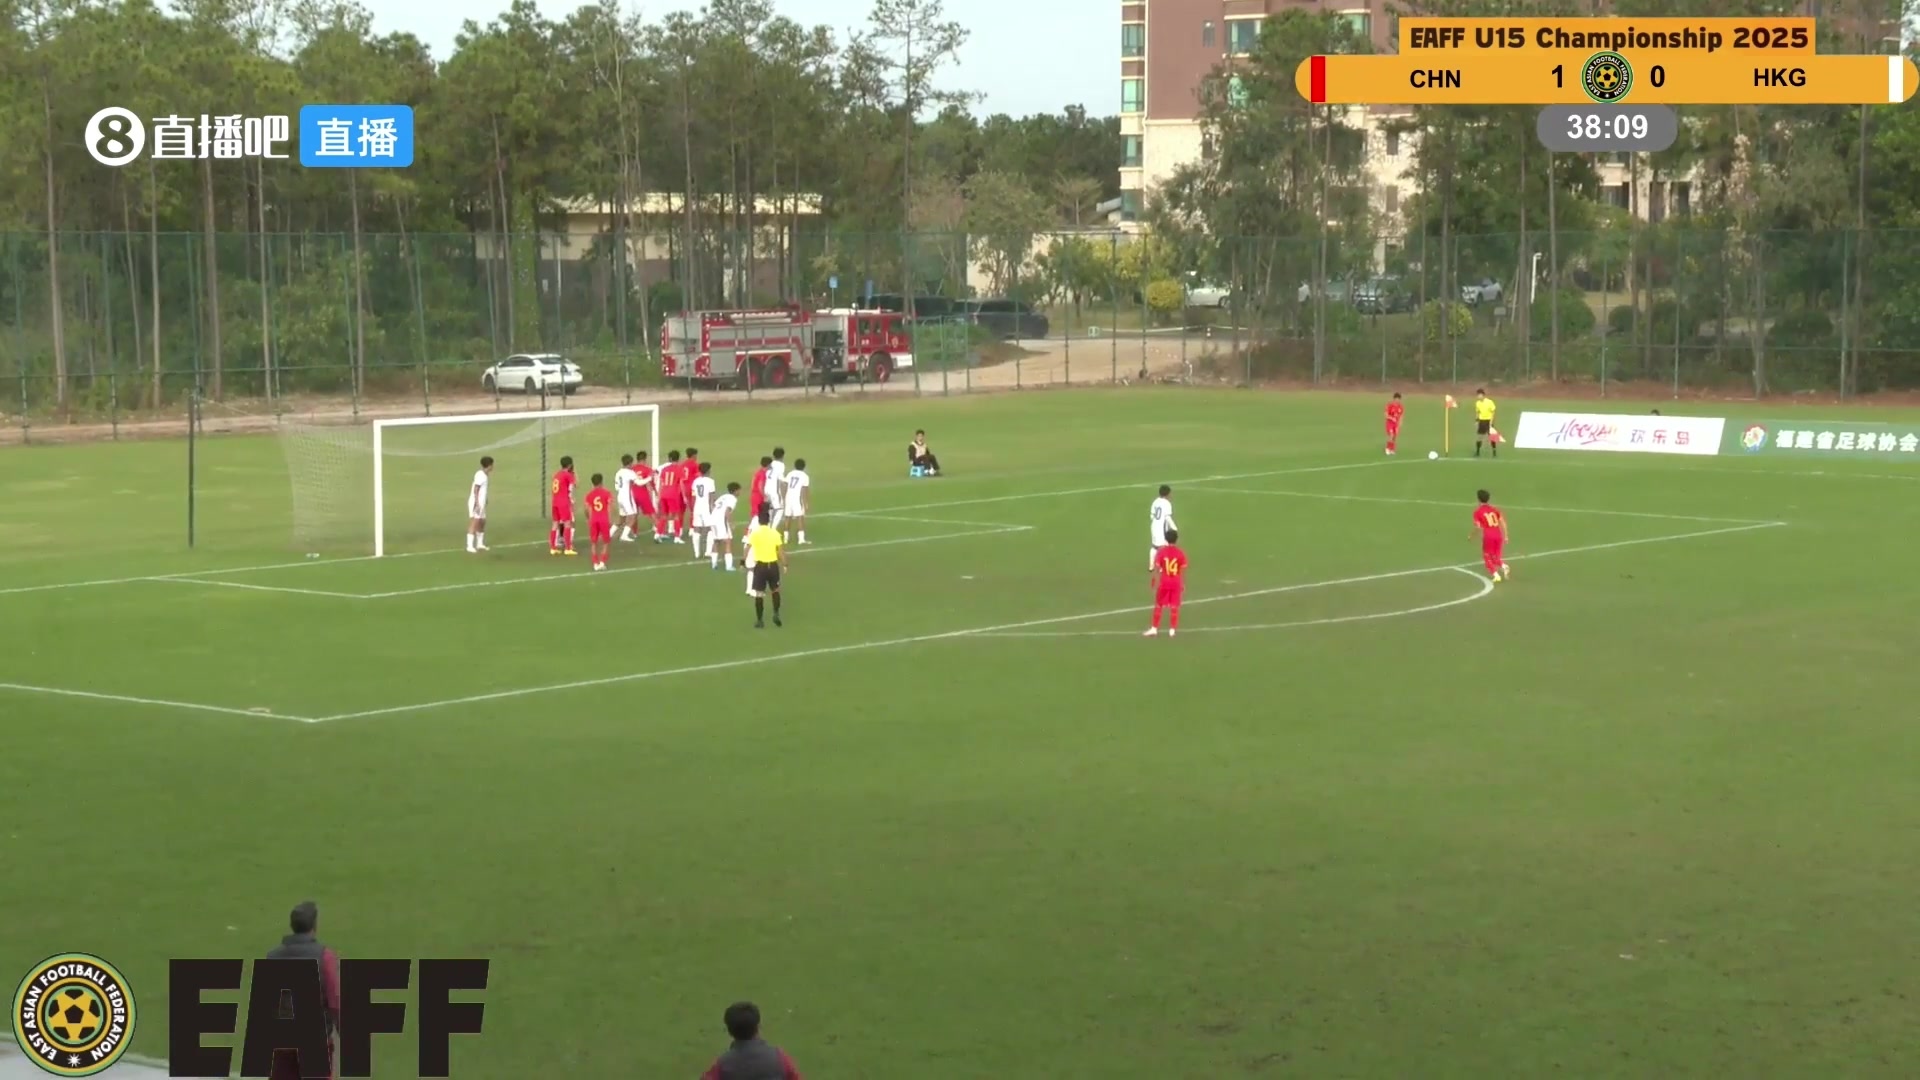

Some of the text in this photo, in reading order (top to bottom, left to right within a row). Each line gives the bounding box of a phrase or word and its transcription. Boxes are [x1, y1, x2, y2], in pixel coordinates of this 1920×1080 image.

[1629, 428, 1691, 446] 欢乐岛
[1774, 428, 1920, 454] 福建省足球协会
[551, 478, 560, 493] 8
[695, 484, 705, 498] 10
[789, 476, 800, 489] 17
[1483, 511, 1499, 528] 10
[1163, 557, 1178, 576] 14
